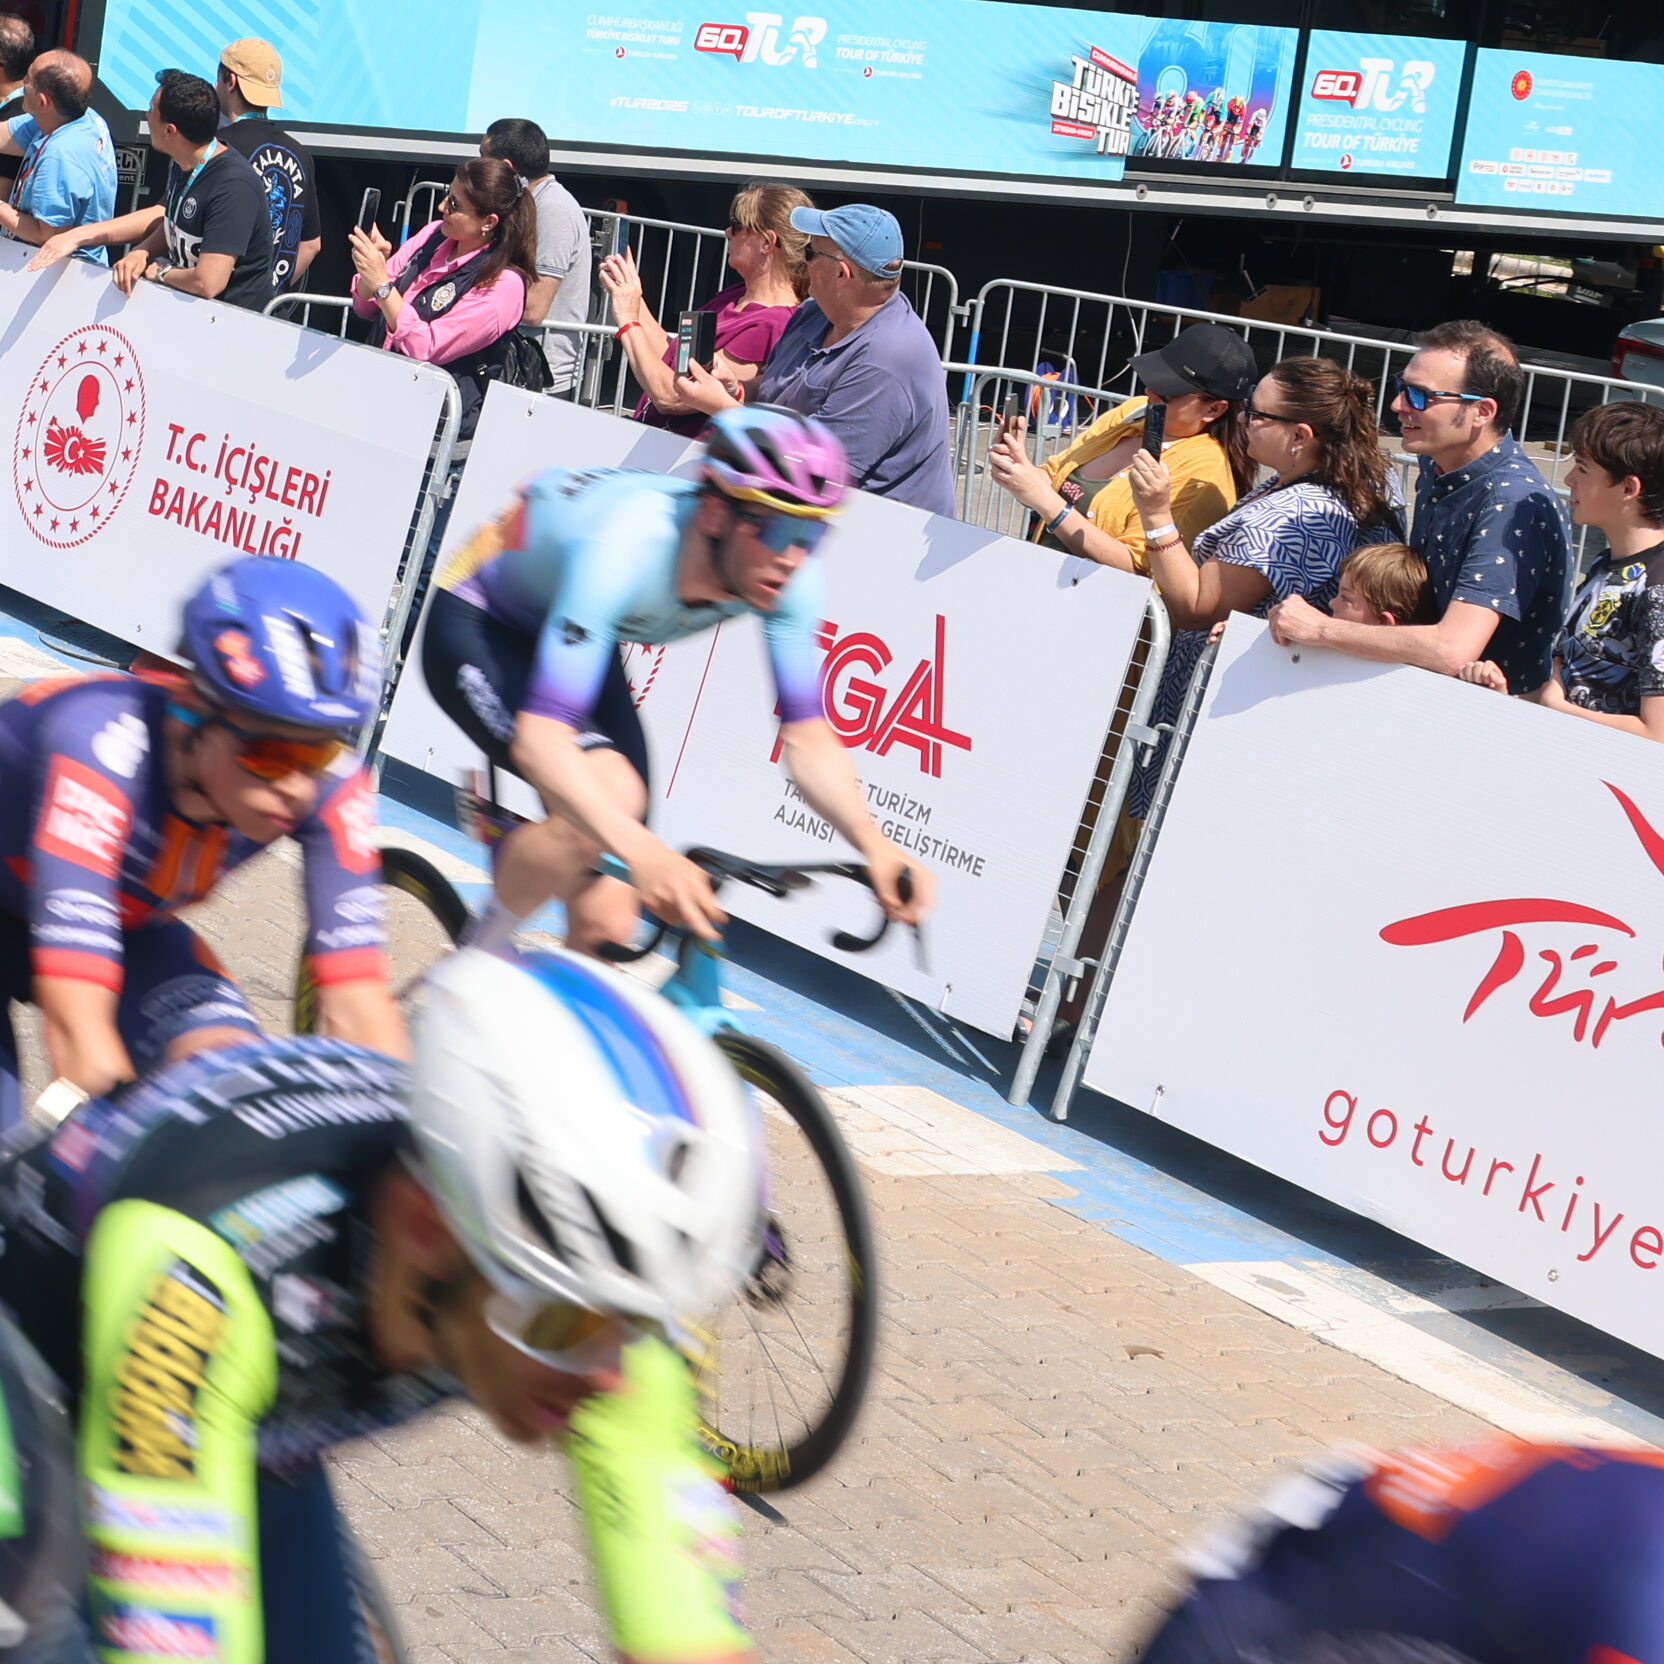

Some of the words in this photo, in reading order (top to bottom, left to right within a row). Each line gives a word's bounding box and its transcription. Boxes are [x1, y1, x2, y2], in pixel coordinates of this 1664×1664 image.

[586, 13, 685, 34] CUMHURBAŞKANLIĞI
[585, 28, 625, 41] TÜRKİYE
[624, 30, 658, 44] BİSİKLET
[697, 27, 744, 50] 60.
[740, 11, 828, 69] TUR
[836, 32, 892, 48] PRESIDENTIAL
[892, 37, 928, 51] CYCLING
[835, 47, 864, 61] TOUR
[864, 49, 880, 62] OF
[880, 47, 925, 66] TÜRKİYE
[1313, 73, 1357, 97] 60.
[1352, 57, 1436, 114] TUR
[609, 96, 689, 113] #TUR2025
[1305, 113, 1379, 130] PRESIDENTIAL
[1379, 116, 1425, 133] CYCLING
[1303, 132, 1343, 149] TOUR
[1343, 134, 1361, 150] OF
[1361, 131, 1421, 153] TÜRKİYE
[1354, 157, 1385, 168] TURKISH
[1385, 159, 1418, 169] AIRLINES
[163, 422, 209, 476] T.C.
[213, 431, 333, 519] İÇİŞLERİ
[147, 476, 303, 562] BAKANLIĞI
[866, 782, 933, 826] TURİZM
[773, 804, 836, 844] AJANSI
[880, 819, 987, 879] GELİŞTİRME
